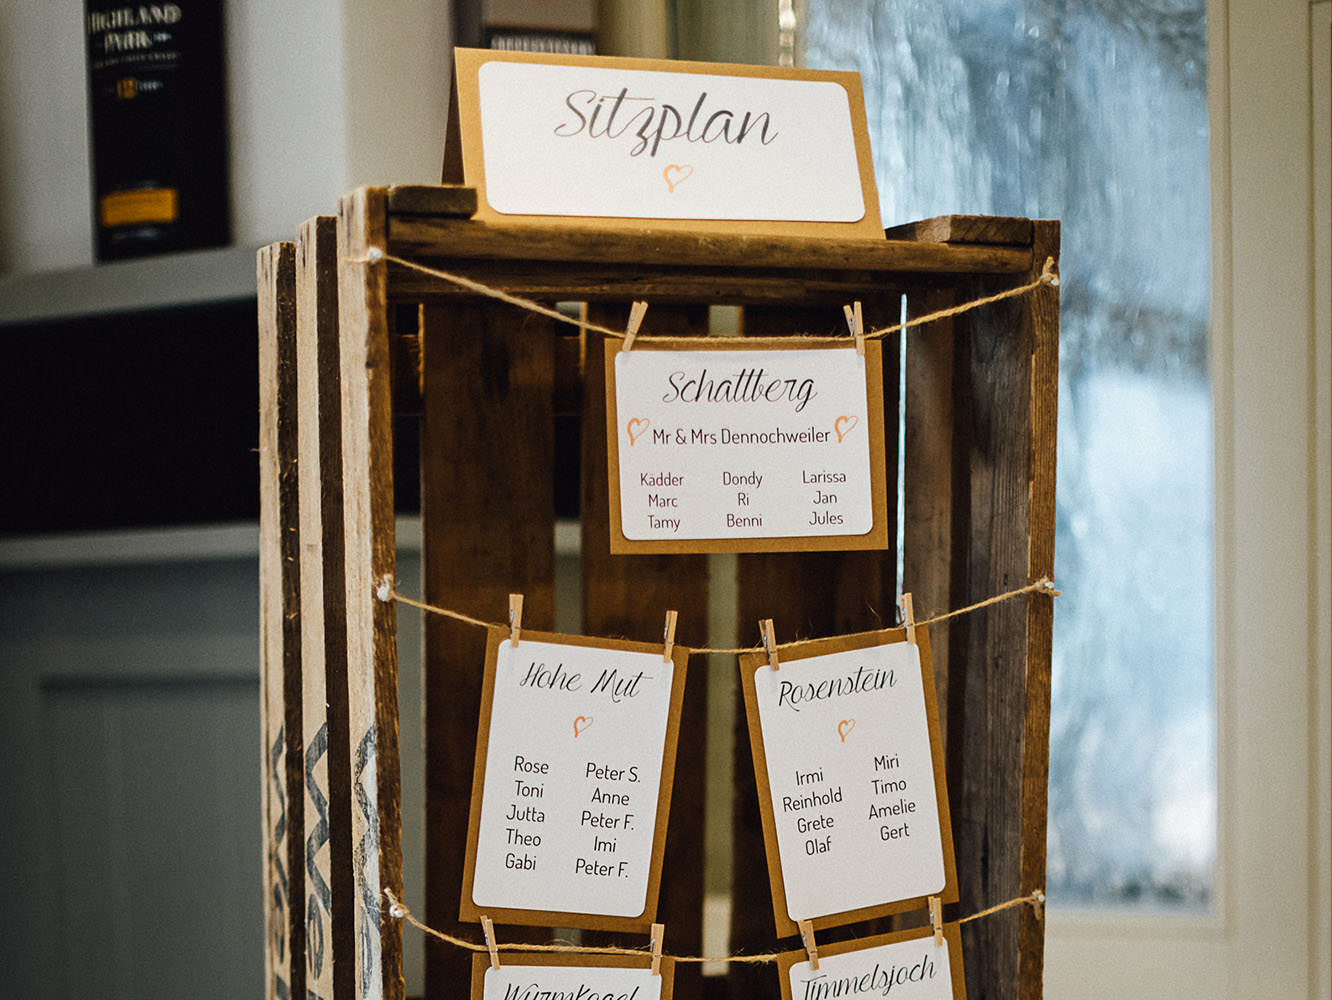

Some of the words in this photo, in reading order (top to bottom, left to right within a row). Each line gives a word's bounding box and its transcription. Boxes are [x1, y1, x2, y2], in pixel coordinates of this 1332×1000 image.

[554, 88, 778, 157] Sitzplan
[663, 369, 817, 412] Schattberg
[653, 429, 671, 444] Mr
[676, 429, 687, 444] &
[691, 429, 717, 444] Mrs
[721, 427, 830, 444] Dennochweiler
[723, 471, 762, 488] Dondy
[803, 470, 846, 483] Larissa
[649, 494, 677, 507] Marc
[738, 492, 749, 506] Ri
[813, 491, 837, 504] Jan
[648, 515, 680, 532] Tamy
[727, 514, 762, 527] Benni
[809, 511, 843, 525] Jules
[520, 662, 580, 691] Hohe
[591, 667, 653, 703] Mut
[779, 666, 897, 712] Rosenstein
[514, 756, 549, 774] Rose
[874, 753, 899, 771] Miri
[586, 763, 625, 780] Peter
[628, 767, 640, 782] S.
[796, 767, 823, 786] Irmi
[515, 780, 543, 798] Toni
[591, 787, 629, 805] Anne
[871, 780, 906, 795] Timo
[783, 786, 842, 812] Reinhold
[506, 804, 544, 822] Jutta
[869, 799, 915, 820] Amelie
[581, 811, 620, 828] Peter
[624, 814, 634, 830] F.
[797, 815, 834, 833] Grete
[506, 828, 541, 846] Theo
[881, 823, 909, 841] Gert
[594, 836, 616, 852] Imi
[806, 836, 831, 855] Olaf
[506, 853, 536, 870] Gabi
[576, 858, 614, 876] Peter
[618, 862, 628, 878] F.
